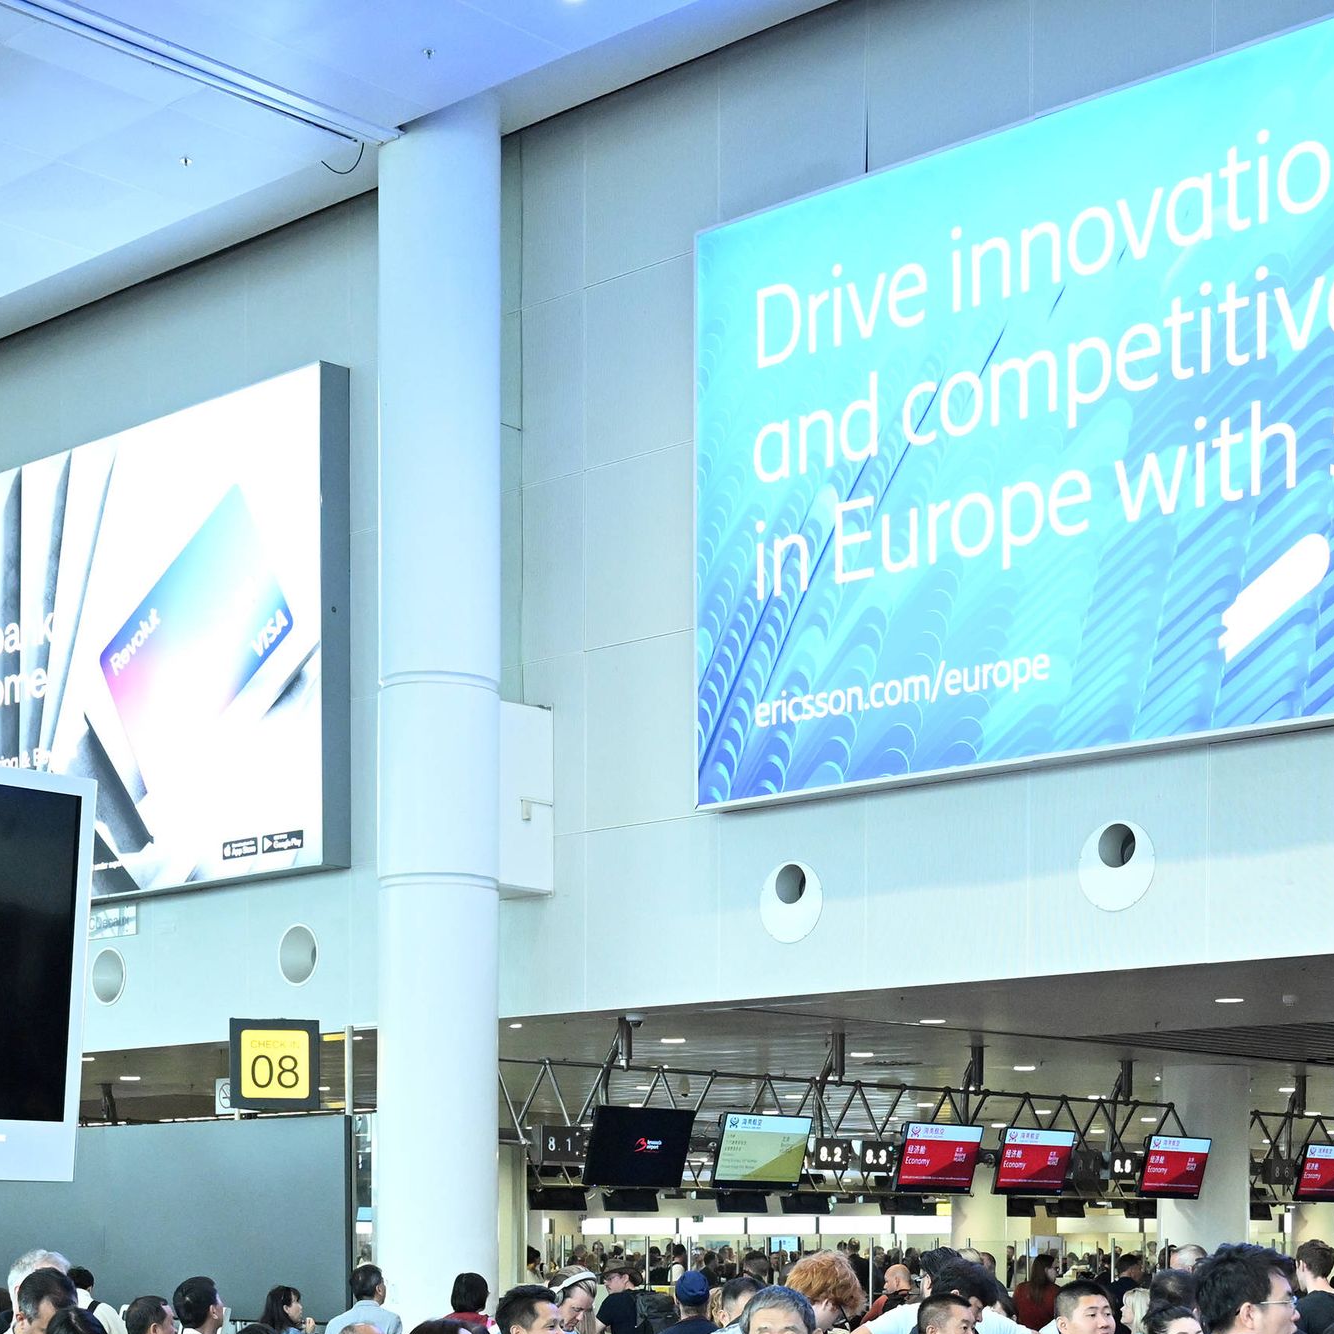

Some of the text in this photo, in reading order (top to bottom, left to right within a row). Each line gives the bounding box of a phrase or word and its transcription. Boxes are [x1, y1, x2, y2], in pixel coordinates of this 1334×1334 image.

[755, 260, 929, 369] Drive
[753, 384, 879, 483] and
[754, 518, 810, 600] in
[832, 468, 1093, 585] Europe
[1116, 397, 1299, 523] with
[251, 609, 288, 657] VISA
[755, 646, 1051, 730] ericsson.com/europe
[89, 915, 130, 931] CDecaux
[251, 1054, 299, 1088] 08
[548, 1136, 572, 1152] 8.1
[819, 1146, 842, 1162] 8.2
[865, 1149, 888, 1164] 8.3
[905, 1156, 930, 1167] Economy
[1003, 1161, 1027, 1171] Economy
[1147, 1165, 1168, 1175] Economy
